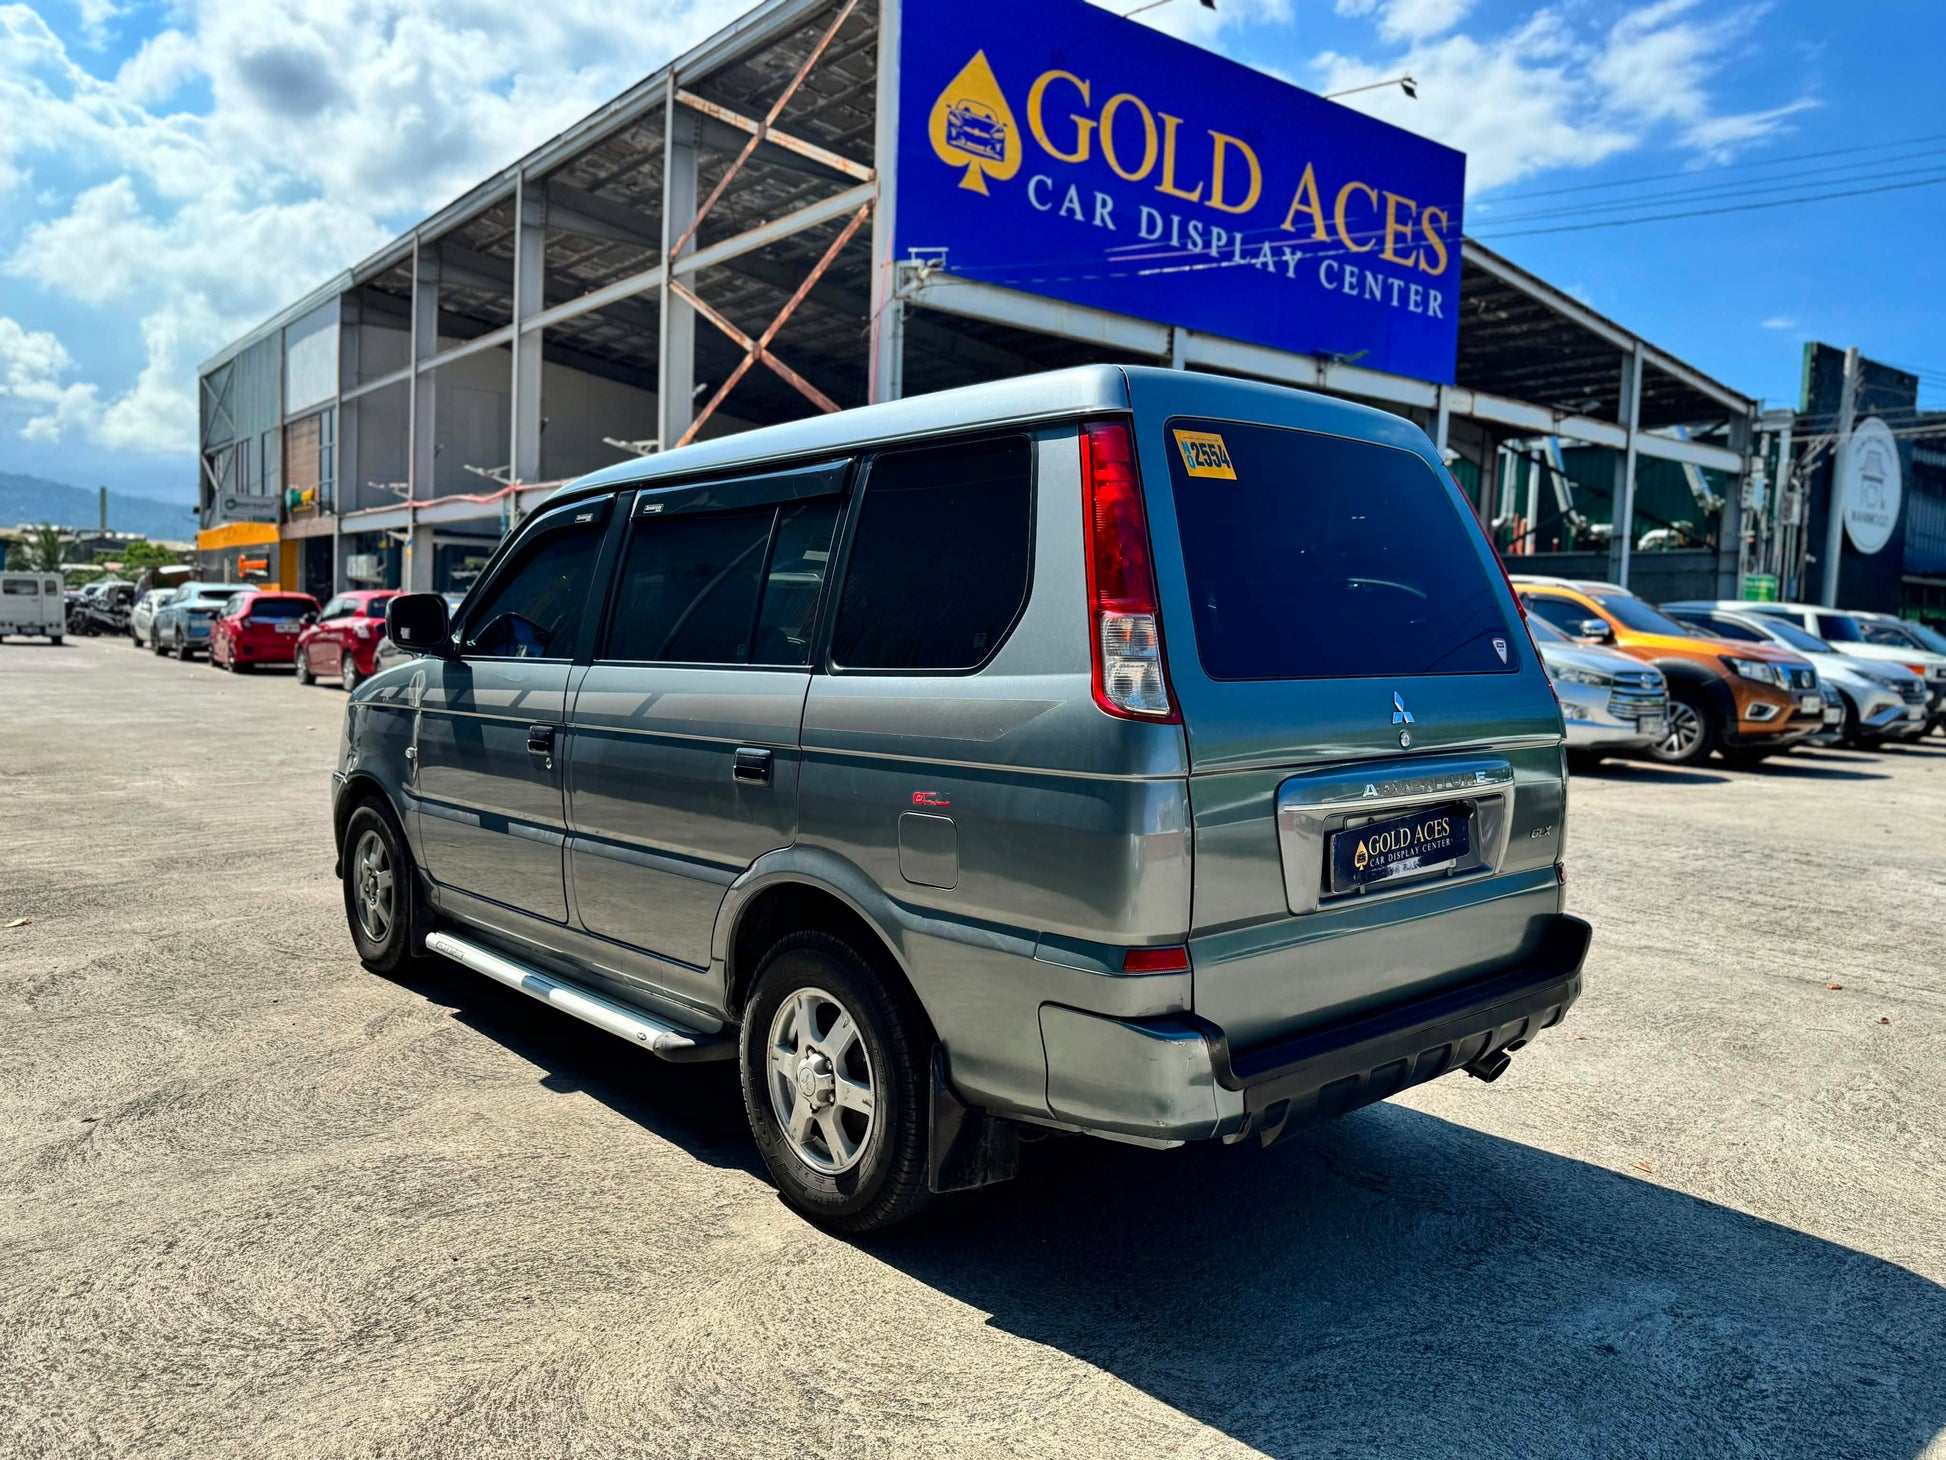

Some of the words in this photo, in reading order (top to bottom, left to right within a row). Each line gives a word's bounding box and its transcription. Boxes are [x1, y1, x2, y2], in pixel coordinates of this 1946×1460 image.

[1027, 69, 1261, 214] GOLD
[1281, 162, 1448, 276] ACES
[1028, 174, 1116, 230] CAR
[1140, 206, 1303, 279] DISPLAY
[1319, 260, 1444, 319] CENTER
[1190, 442, 1231, 469] 2554
[1369, 828, 1411, 855] GOLD
[1415, 817, 1450, 844] ACES
[1370, 856, 1385, 867] CAR
[1388, 846, 1420, 862] DISPLAY
[1422, 839, 1451, 852] CENTER
